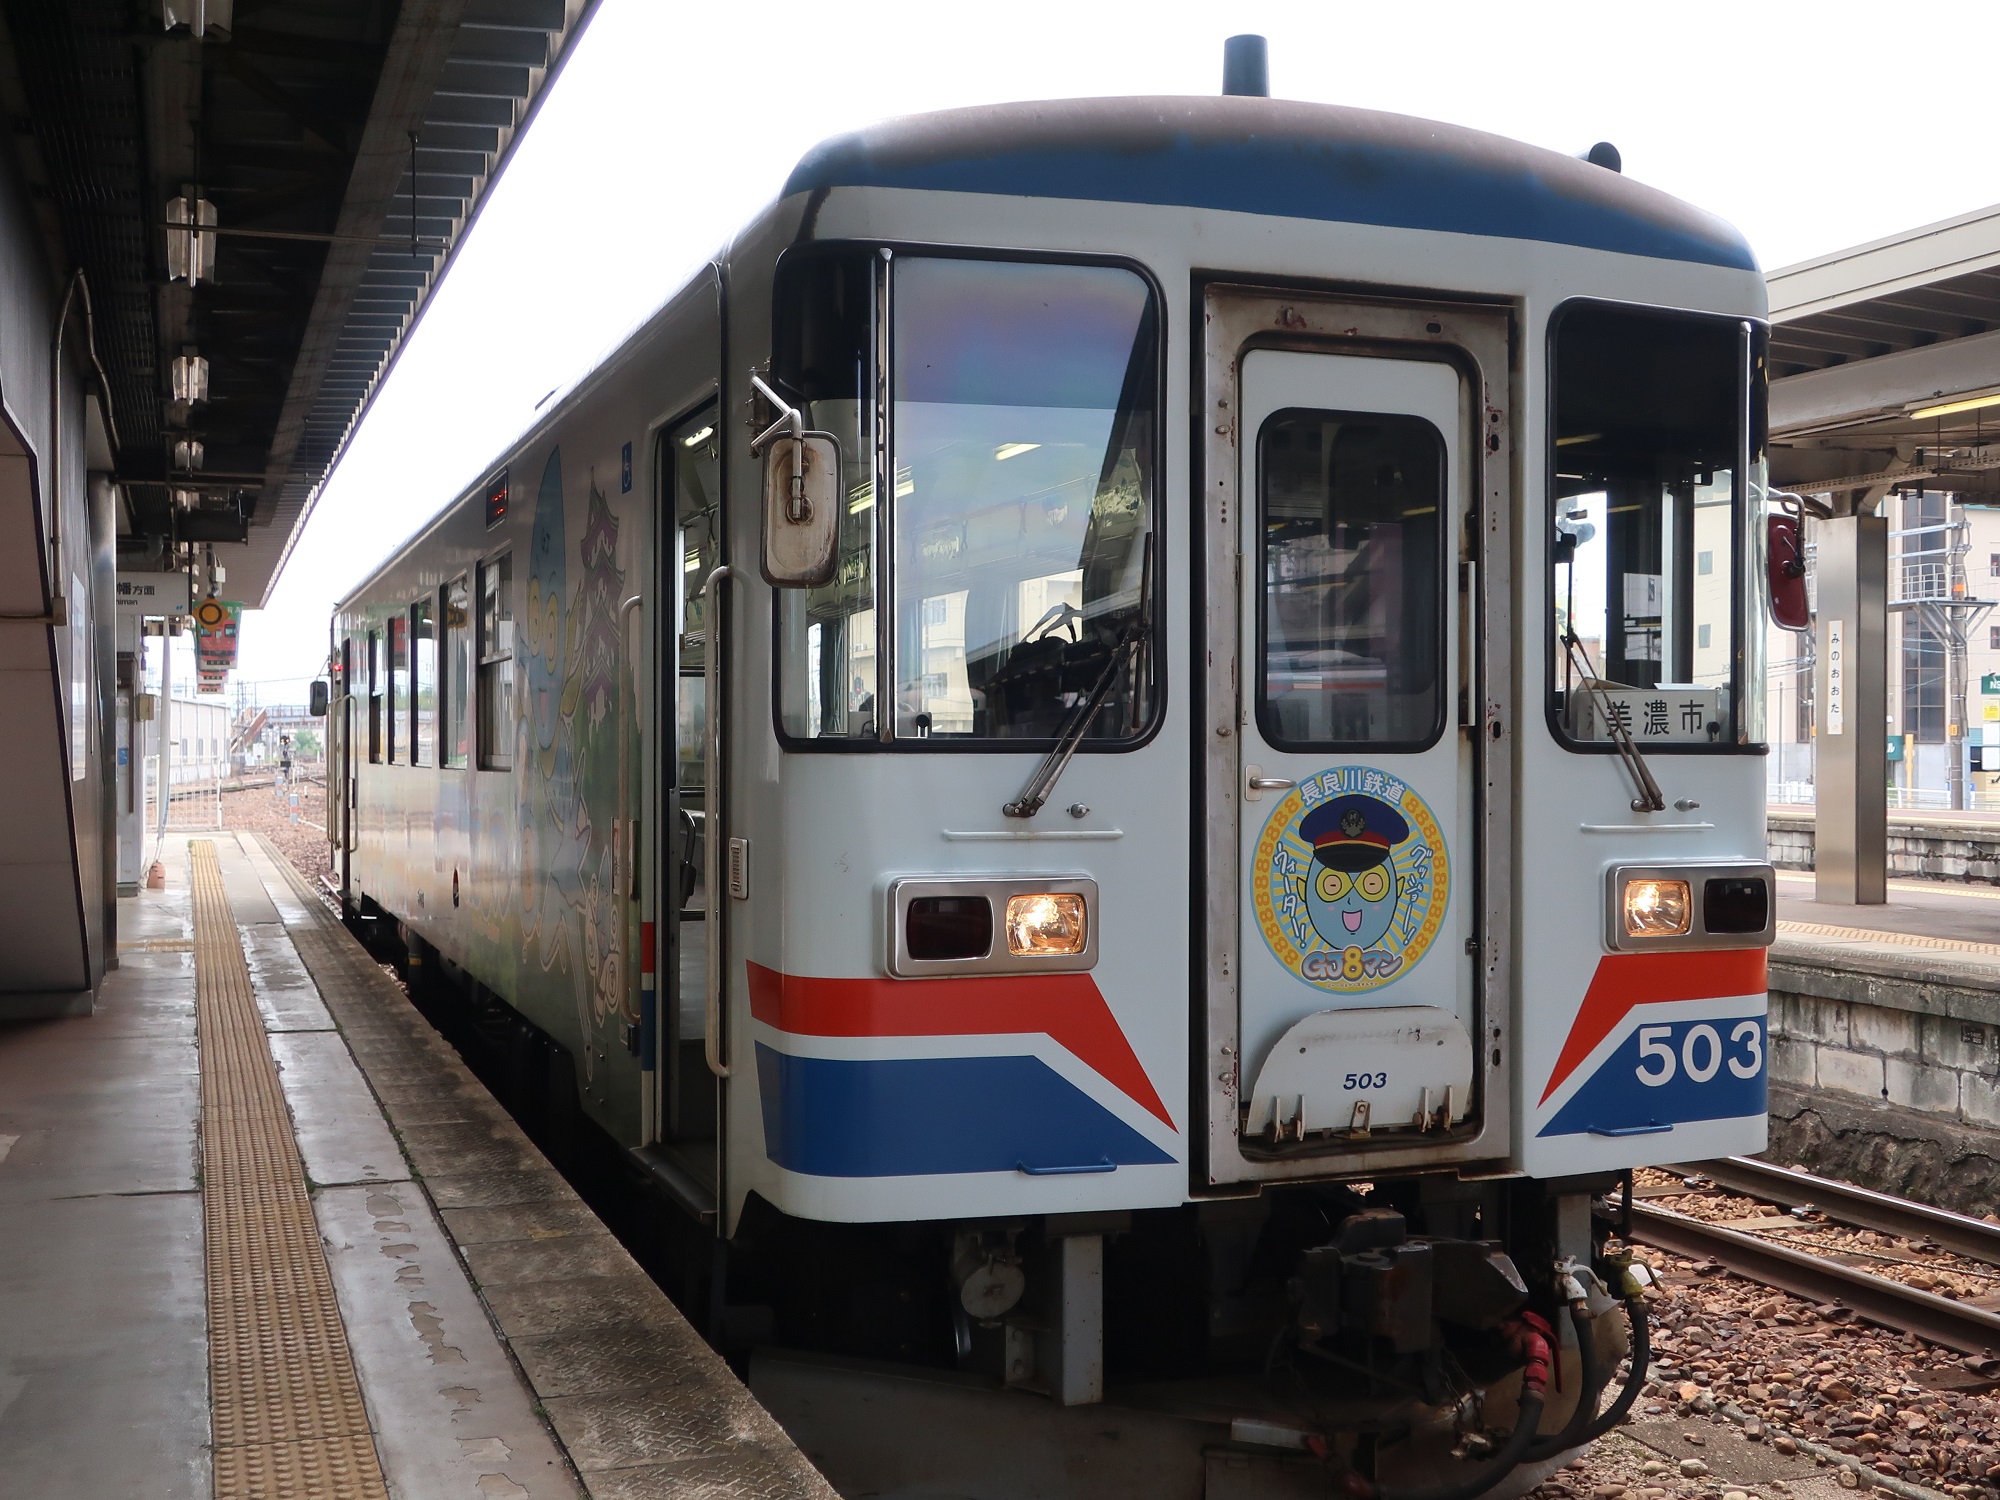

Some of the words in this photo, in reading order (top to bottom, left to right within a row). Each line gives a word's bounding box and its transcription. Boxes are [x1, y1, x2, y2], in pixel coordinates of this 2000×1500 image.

[1830, 633, 1840, 714] みのおおた
[1605, 699, 1705, 737] 美濃市
[1301, 769, 1406, 806] 長良川鉄道
[1301, 946, 1404, 982] GJ8マン
[1635, 1020, 1763, 1087] 503
[1343, 1072, 1387, 1090] 503
